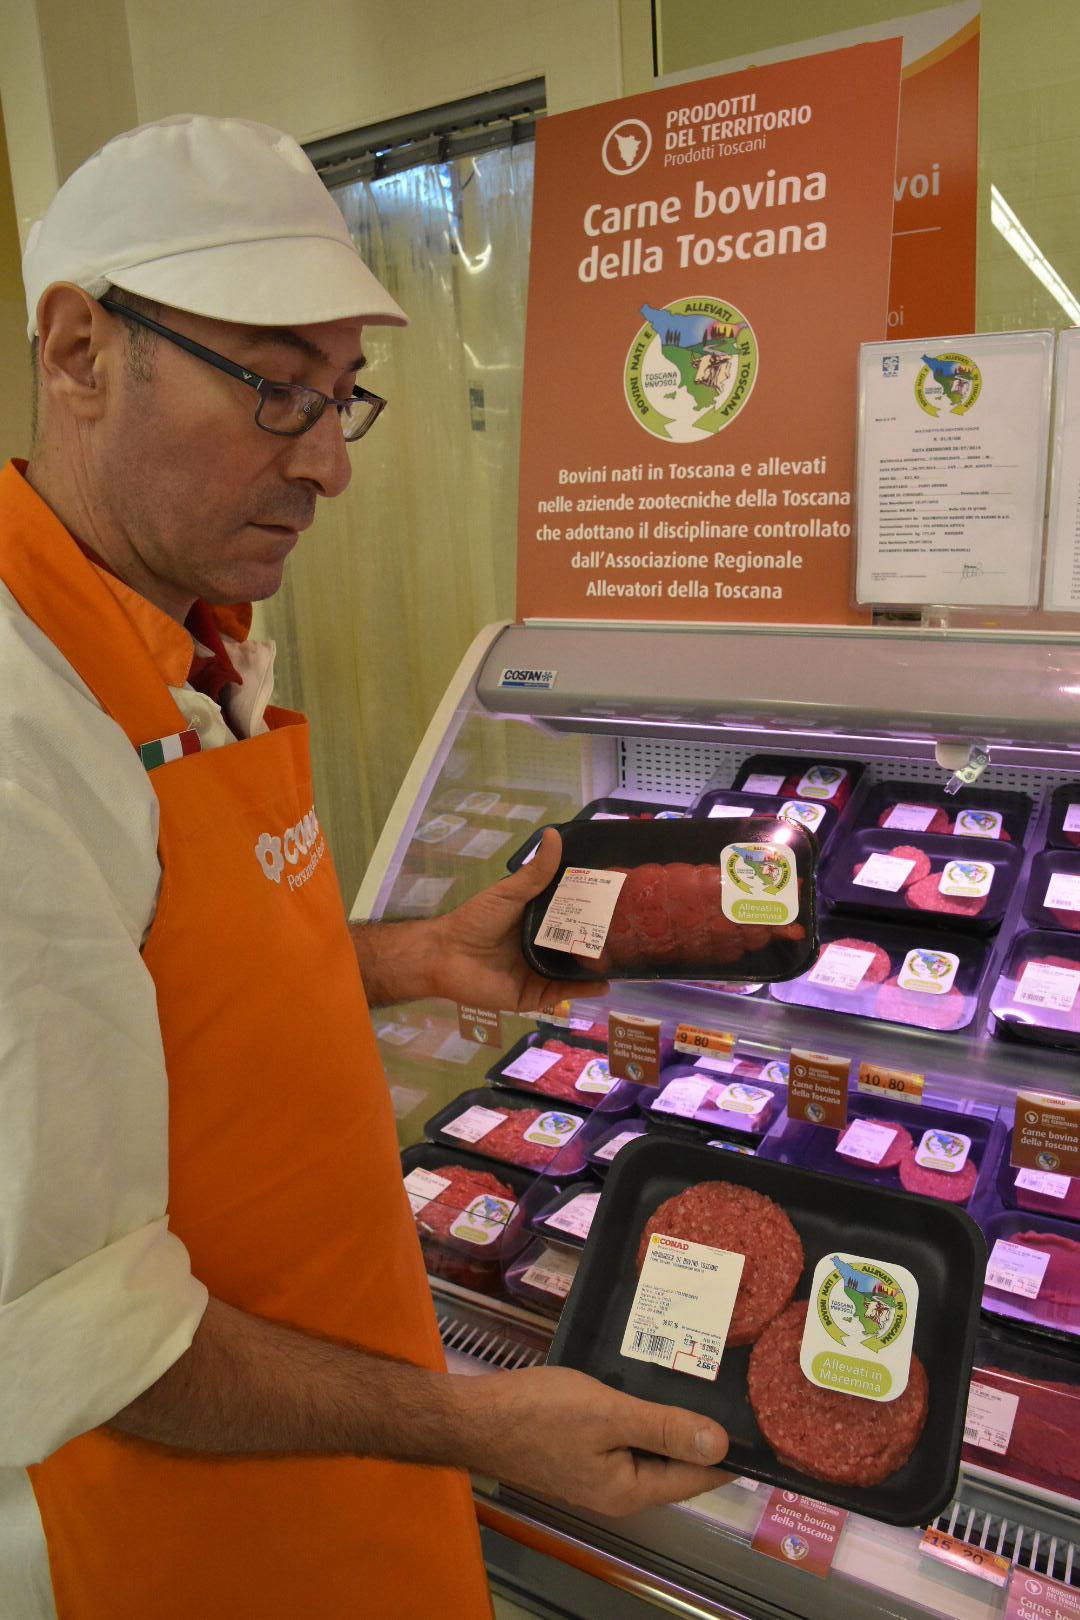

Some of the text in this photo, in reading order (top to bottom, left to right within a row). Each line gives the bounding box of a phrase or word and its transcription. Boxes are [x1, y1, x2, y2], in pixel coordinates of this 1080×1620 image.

[666, 93, 756, 129] PRODOTTI
[665, 105, 812, 150] DEL TERRITORIO
[664, 135, 767, 167] Prodotti Toscani
[894, 163, 941, 201] voi
[583, 169, 827, 237] Carne bovina
[578, 221, 827, 283] della Toscana
[684, 303, 732, 322] ALLEVATI
[887, 305, 905, 327] oi
[630, 343, 645, 371] NATI
[740, 341, 750, 356] IN
[645, 371, 677, 381] TOSCANA
[630, 377, 649, 415] BOVINI
[720, 363, 751, 417] TOSCANA
[558, 456, 827, 485] Bovini nati in Toscana e allevati
[537, 489, 851, 514] nelle aziende zootecniche della Toscana
[536, 519, 851, 543] che adottano il disciplinare controllato
[713, 550, 803, 573] Regionale
[585, 580, 784, 600] Allevatori della Toscana
[504, 670, 542, 681] COSTAN
[738, 912, 782, 920] Maremma
[739, 904, 771, 912] Allevati
[613, 1048, 657, 1064] della Toscana
[614, 1040, 656, 1054] Carne bovina
[791, 1088, 841, 1104] della Toscana
[793, 1079, 841, 1096] Carne bovina
[1020, 1136, 1079, 1152] della Toscana
[1022, 1128, 1079, 1143] Carne bovina
[659, 1239, 689, 1251] CONAD
[861, 1266, 894, 1285] ALLEVATI
[822, 1280, 834, 1296] NATI
[821, 1299, 832, 1327] BOVINI
[881, 1314, 904, 1345] TOSCANA
[819, 1368, 881, 1393] Maremma
[823, 1358, 882, 1381] Allevati in
[771, 1513, 834, 1542] della Toscana
[776, 1504, 836, 1532] Carne bovina
[1017, 1608, 1044, 1620] dell
[1020, 1597, 1052, 1616] Carne
[1055, 1610, 1073, 1620] bo
